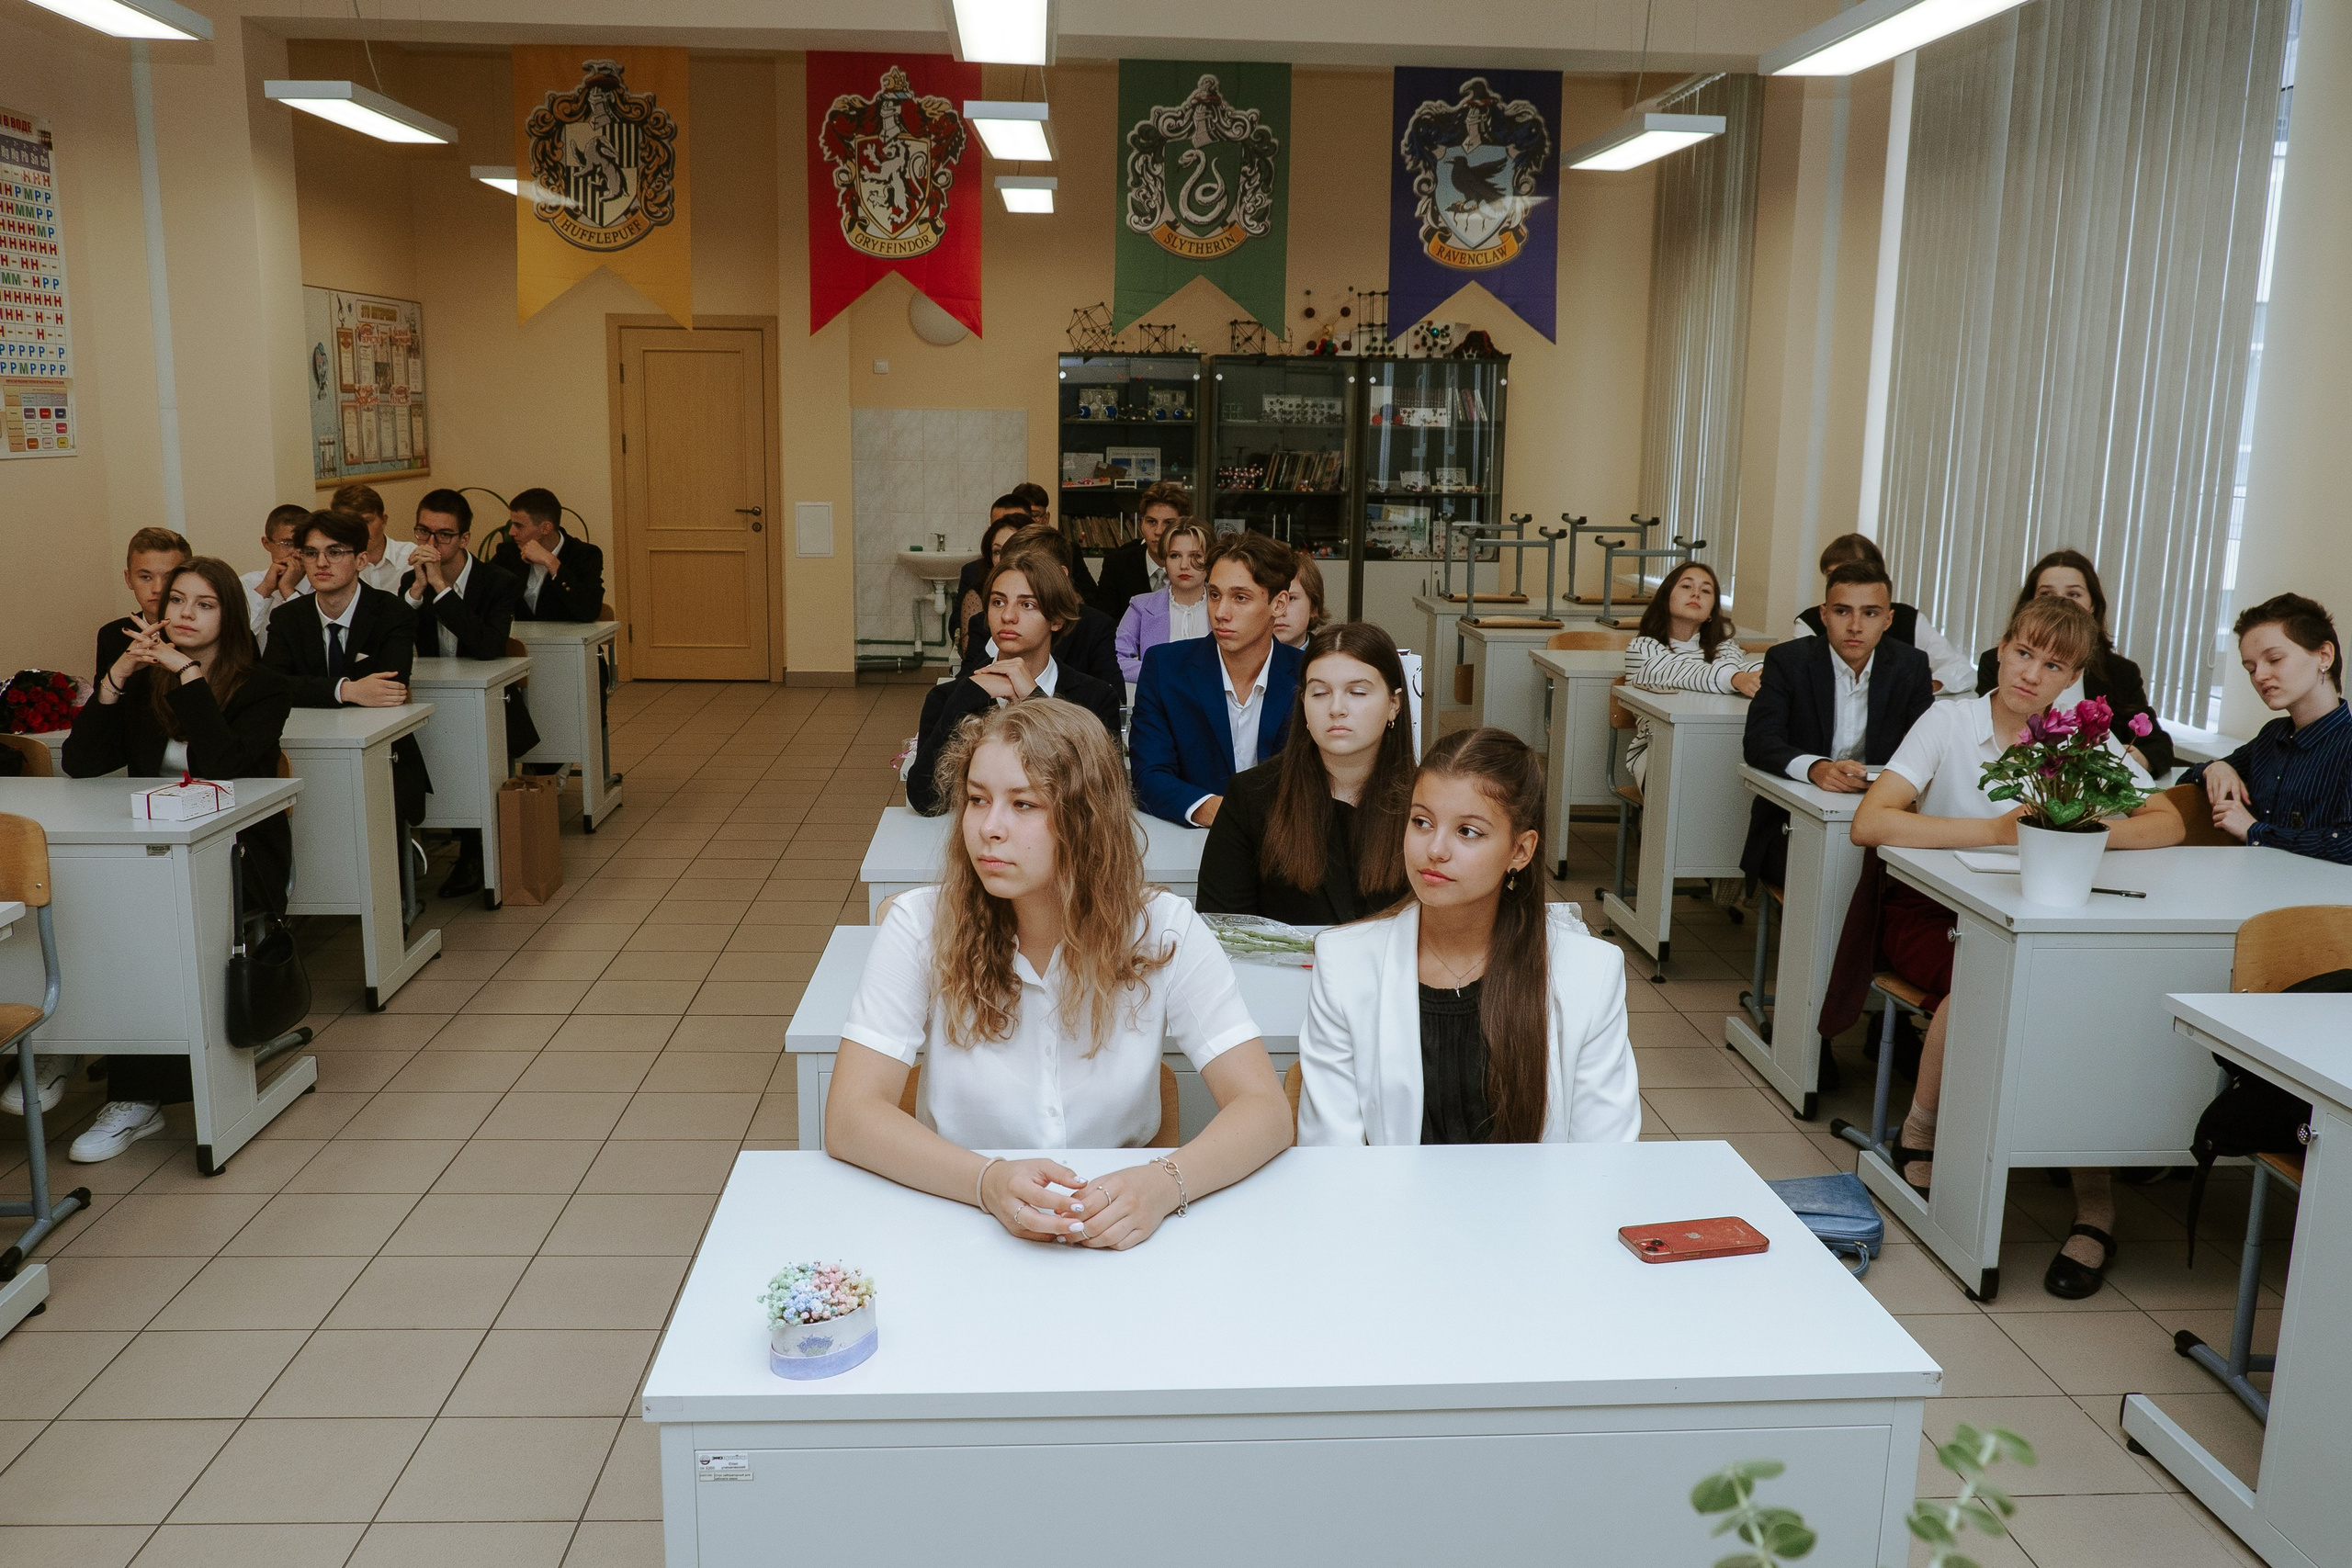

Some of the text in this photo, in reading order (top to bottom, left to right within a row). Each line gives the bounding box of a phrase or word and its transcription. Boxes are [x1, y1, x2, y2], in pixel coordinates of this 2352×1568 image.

[10, 117, 32, 134] ВОДЕ
[560, 219, 643, 244] HUFFLEPUFF
[854, 232, 933, 254] GRYFFINDOR
[1163, 232, 1238, 254] SLYTHERIN
[1436, 244, 1508, 265] RAVENCLAW
